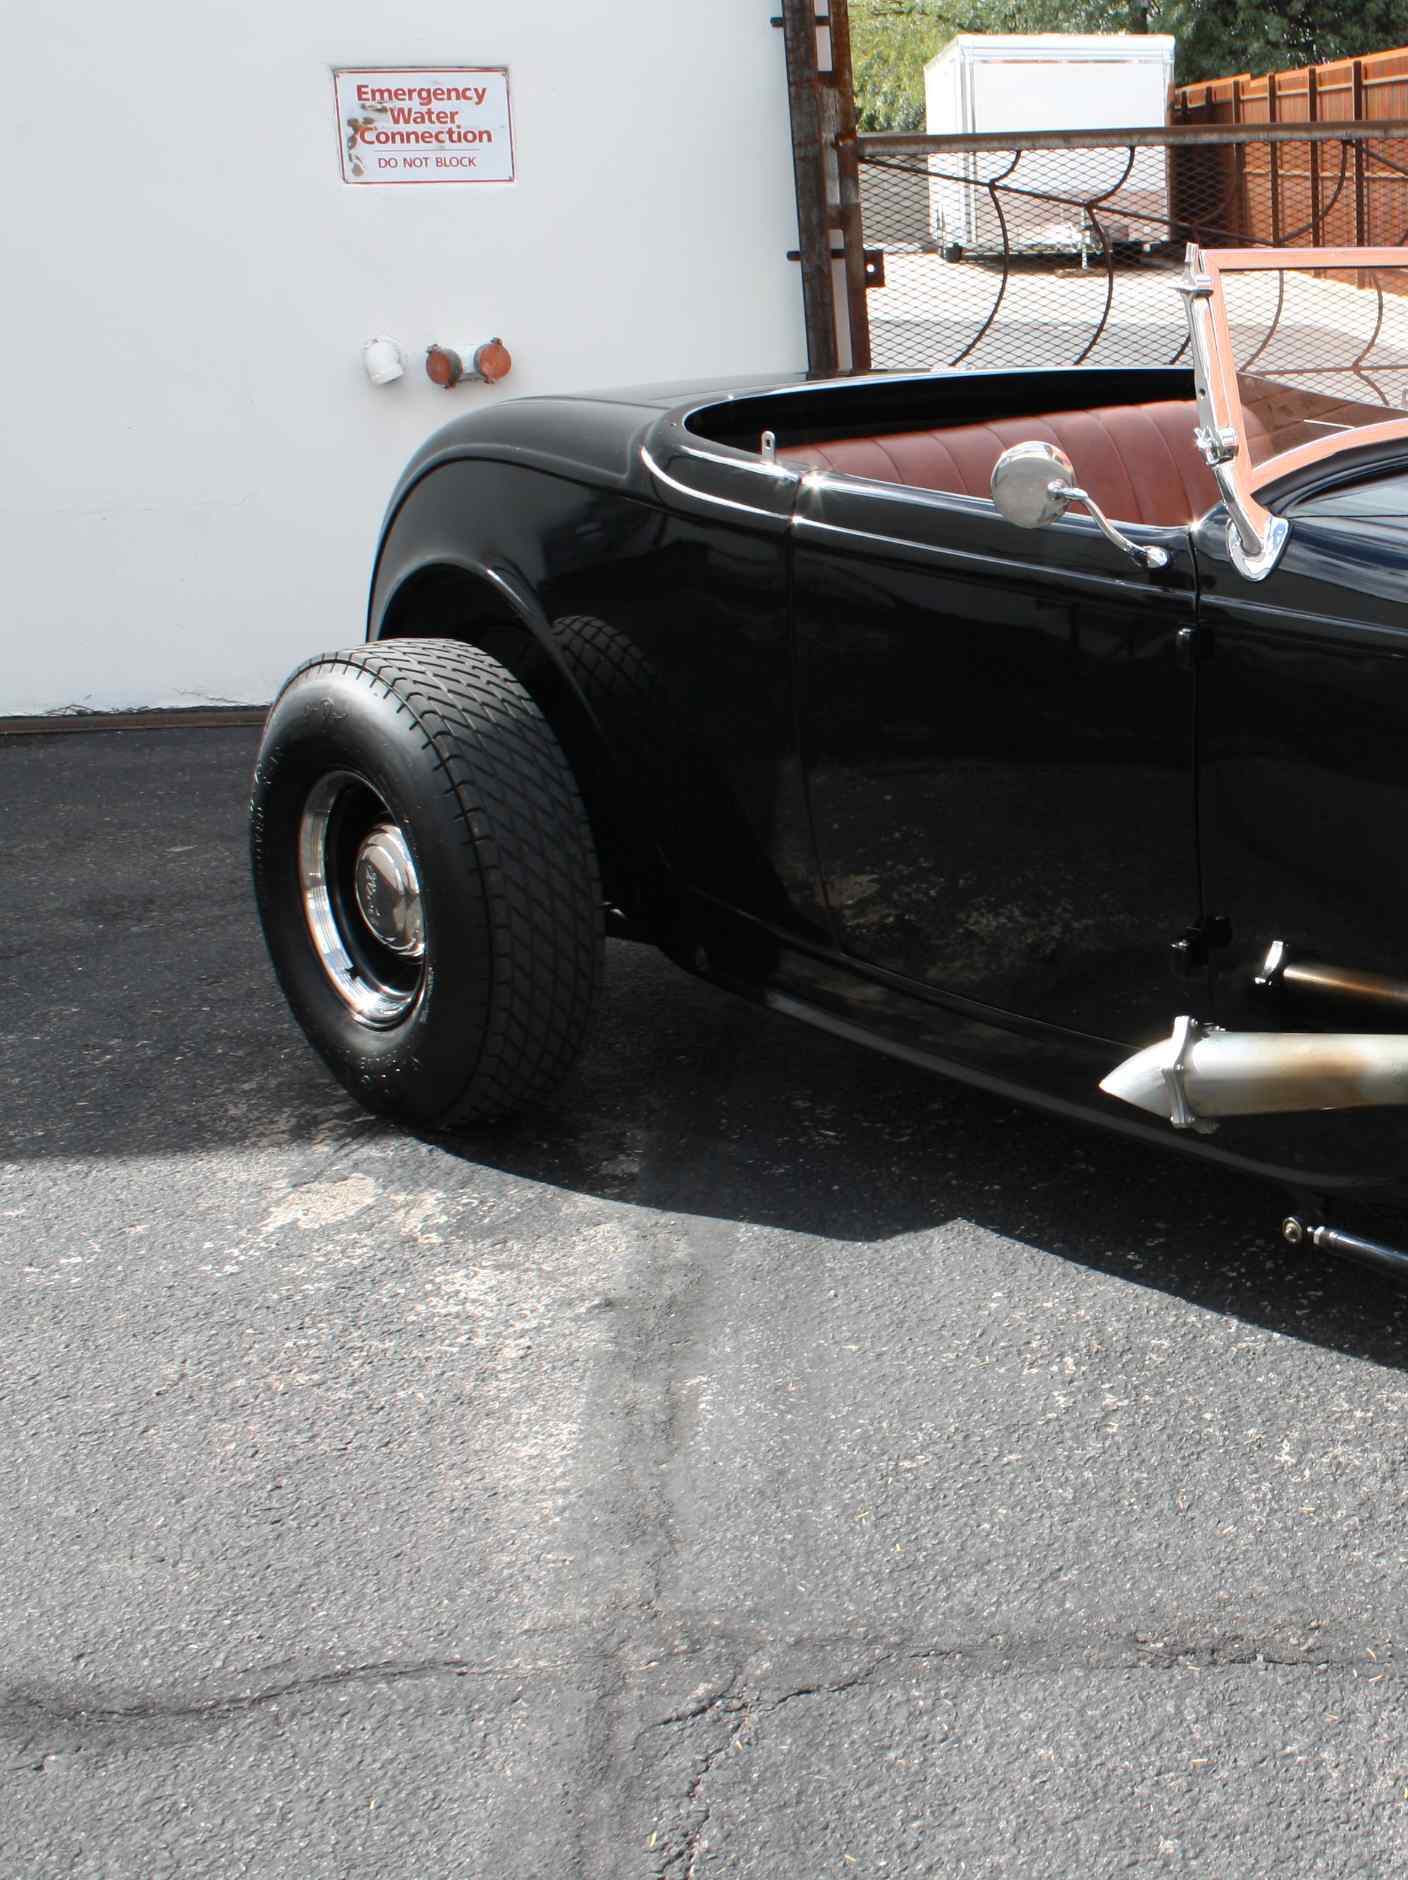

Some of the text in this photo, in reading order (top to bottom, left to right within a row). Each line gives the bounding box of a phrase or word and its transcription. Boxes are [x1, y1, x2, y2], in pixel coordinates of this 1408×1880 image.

[356, 84, 487, 105] Emergency
[388, 106, 460, 125] Water
[359, 125, 493, 145] Connection
[378, 156, 477, 169] DO NOT BLOCK
